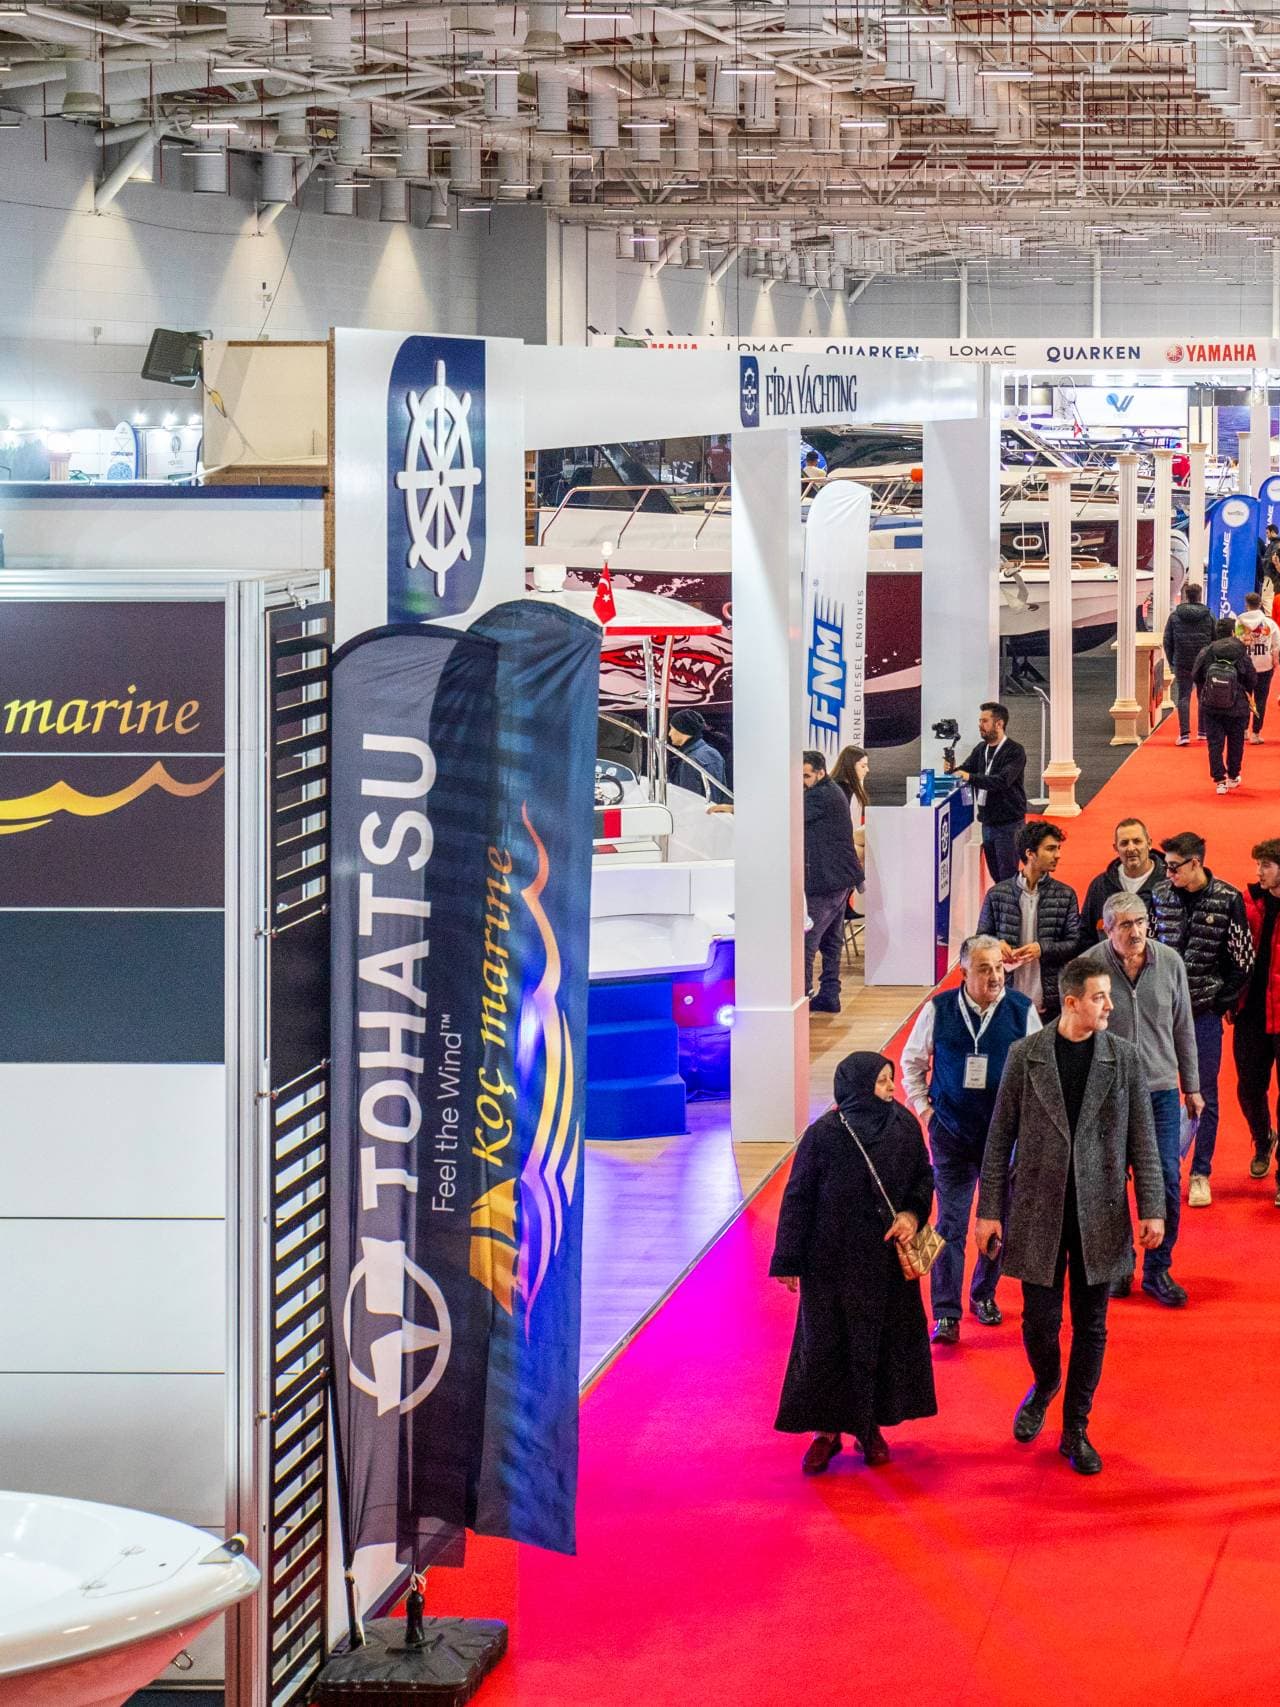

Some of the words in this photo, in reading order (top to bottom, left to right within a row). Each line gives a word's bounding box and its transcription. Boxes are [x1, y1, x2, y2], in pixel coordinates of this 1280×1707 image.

[949, 345, 1017, 356] LOMAC
[1046, 346, 1141, 363] QUARKEN
[1185, 344, 1257, 362] YAMAHA
[798, 364, 858, 414] YACHTING
[855, 590, 864, 648] ENGINES
[812, 625, 845, 727] FNM
[853, 655, 863, 702] DIESEL
[3, 684, 200, 735] marine
[852, 708, 863, 748] ARINE
[359, 733, 437, 1211] TOHATSU
[434, 1107, 459, 1152] the
[432, 1157, 455, 1214] Feel
